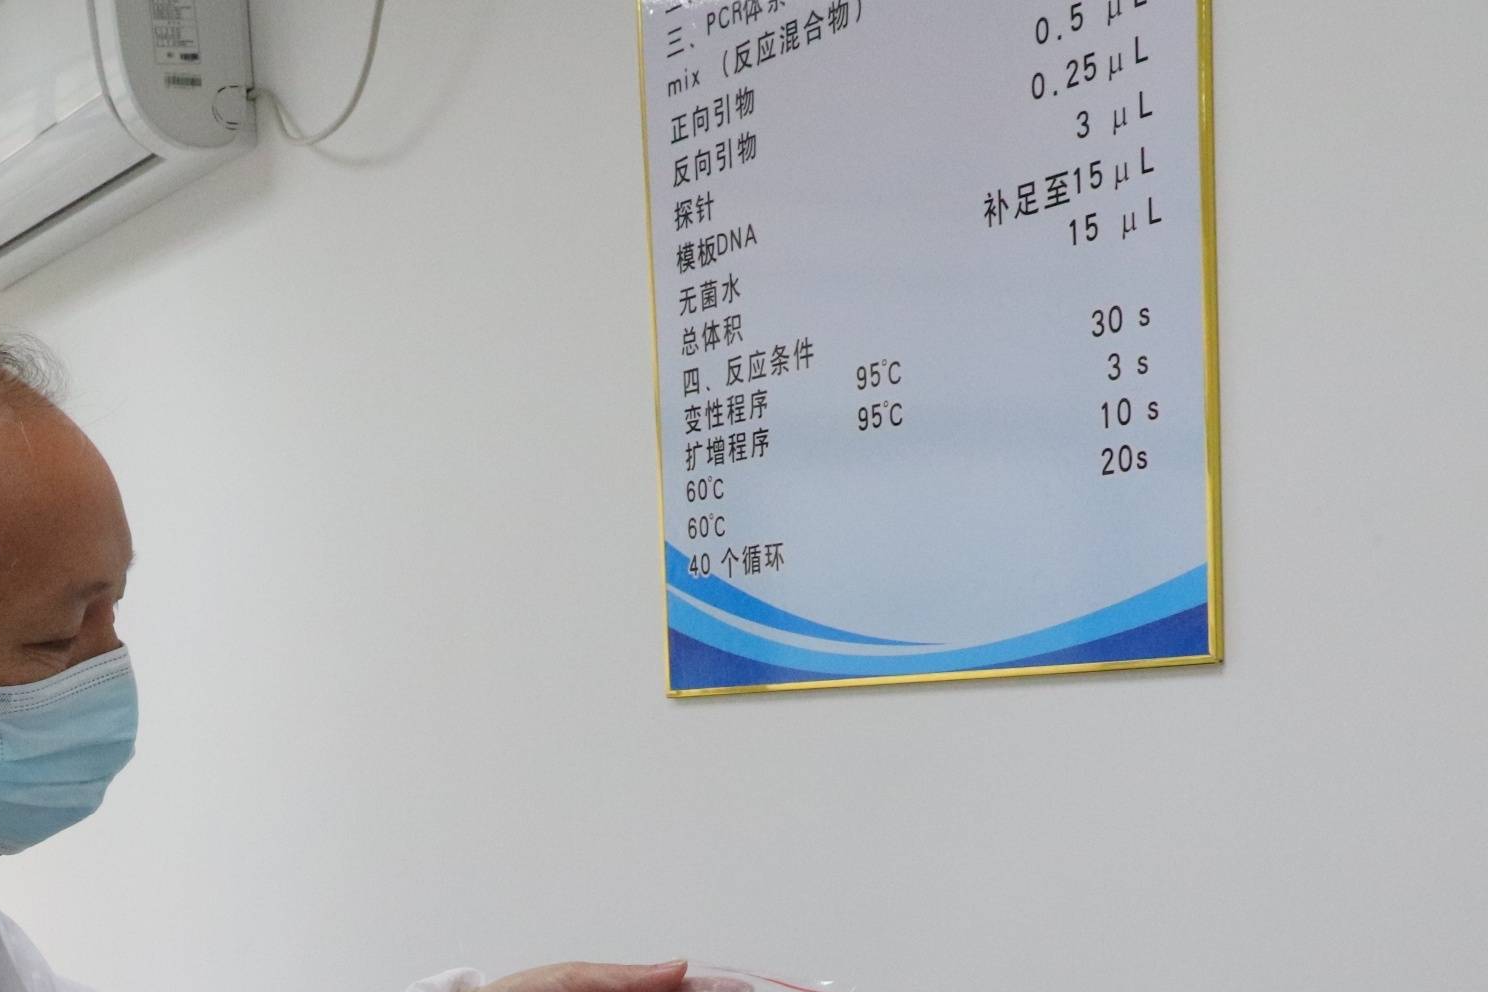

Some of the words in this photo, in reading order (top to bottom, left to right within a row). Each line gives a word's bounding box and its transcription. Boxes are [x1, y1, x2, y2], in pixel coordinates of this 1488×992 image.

[671, 86, 755, 144] 正向引物
[1076, 110, 1091, 139] 3
[673, 131, 757, 188] 反向引物
[674, 191, 715, 232] 探针
[1069, 213, 1099, 247] 15
[676, 223, 758, 275] 模板DNA
[679, 273, 741, 317] 无菌水
[681, 314, 744, 357] 总体积
[683, 337, 815, 398] 四、反应条件
[684, 389, 768, 435] 变性程序
[685, 427, 770, 472] 扩增程序
[1101, 444, 1148, 476] 20s
